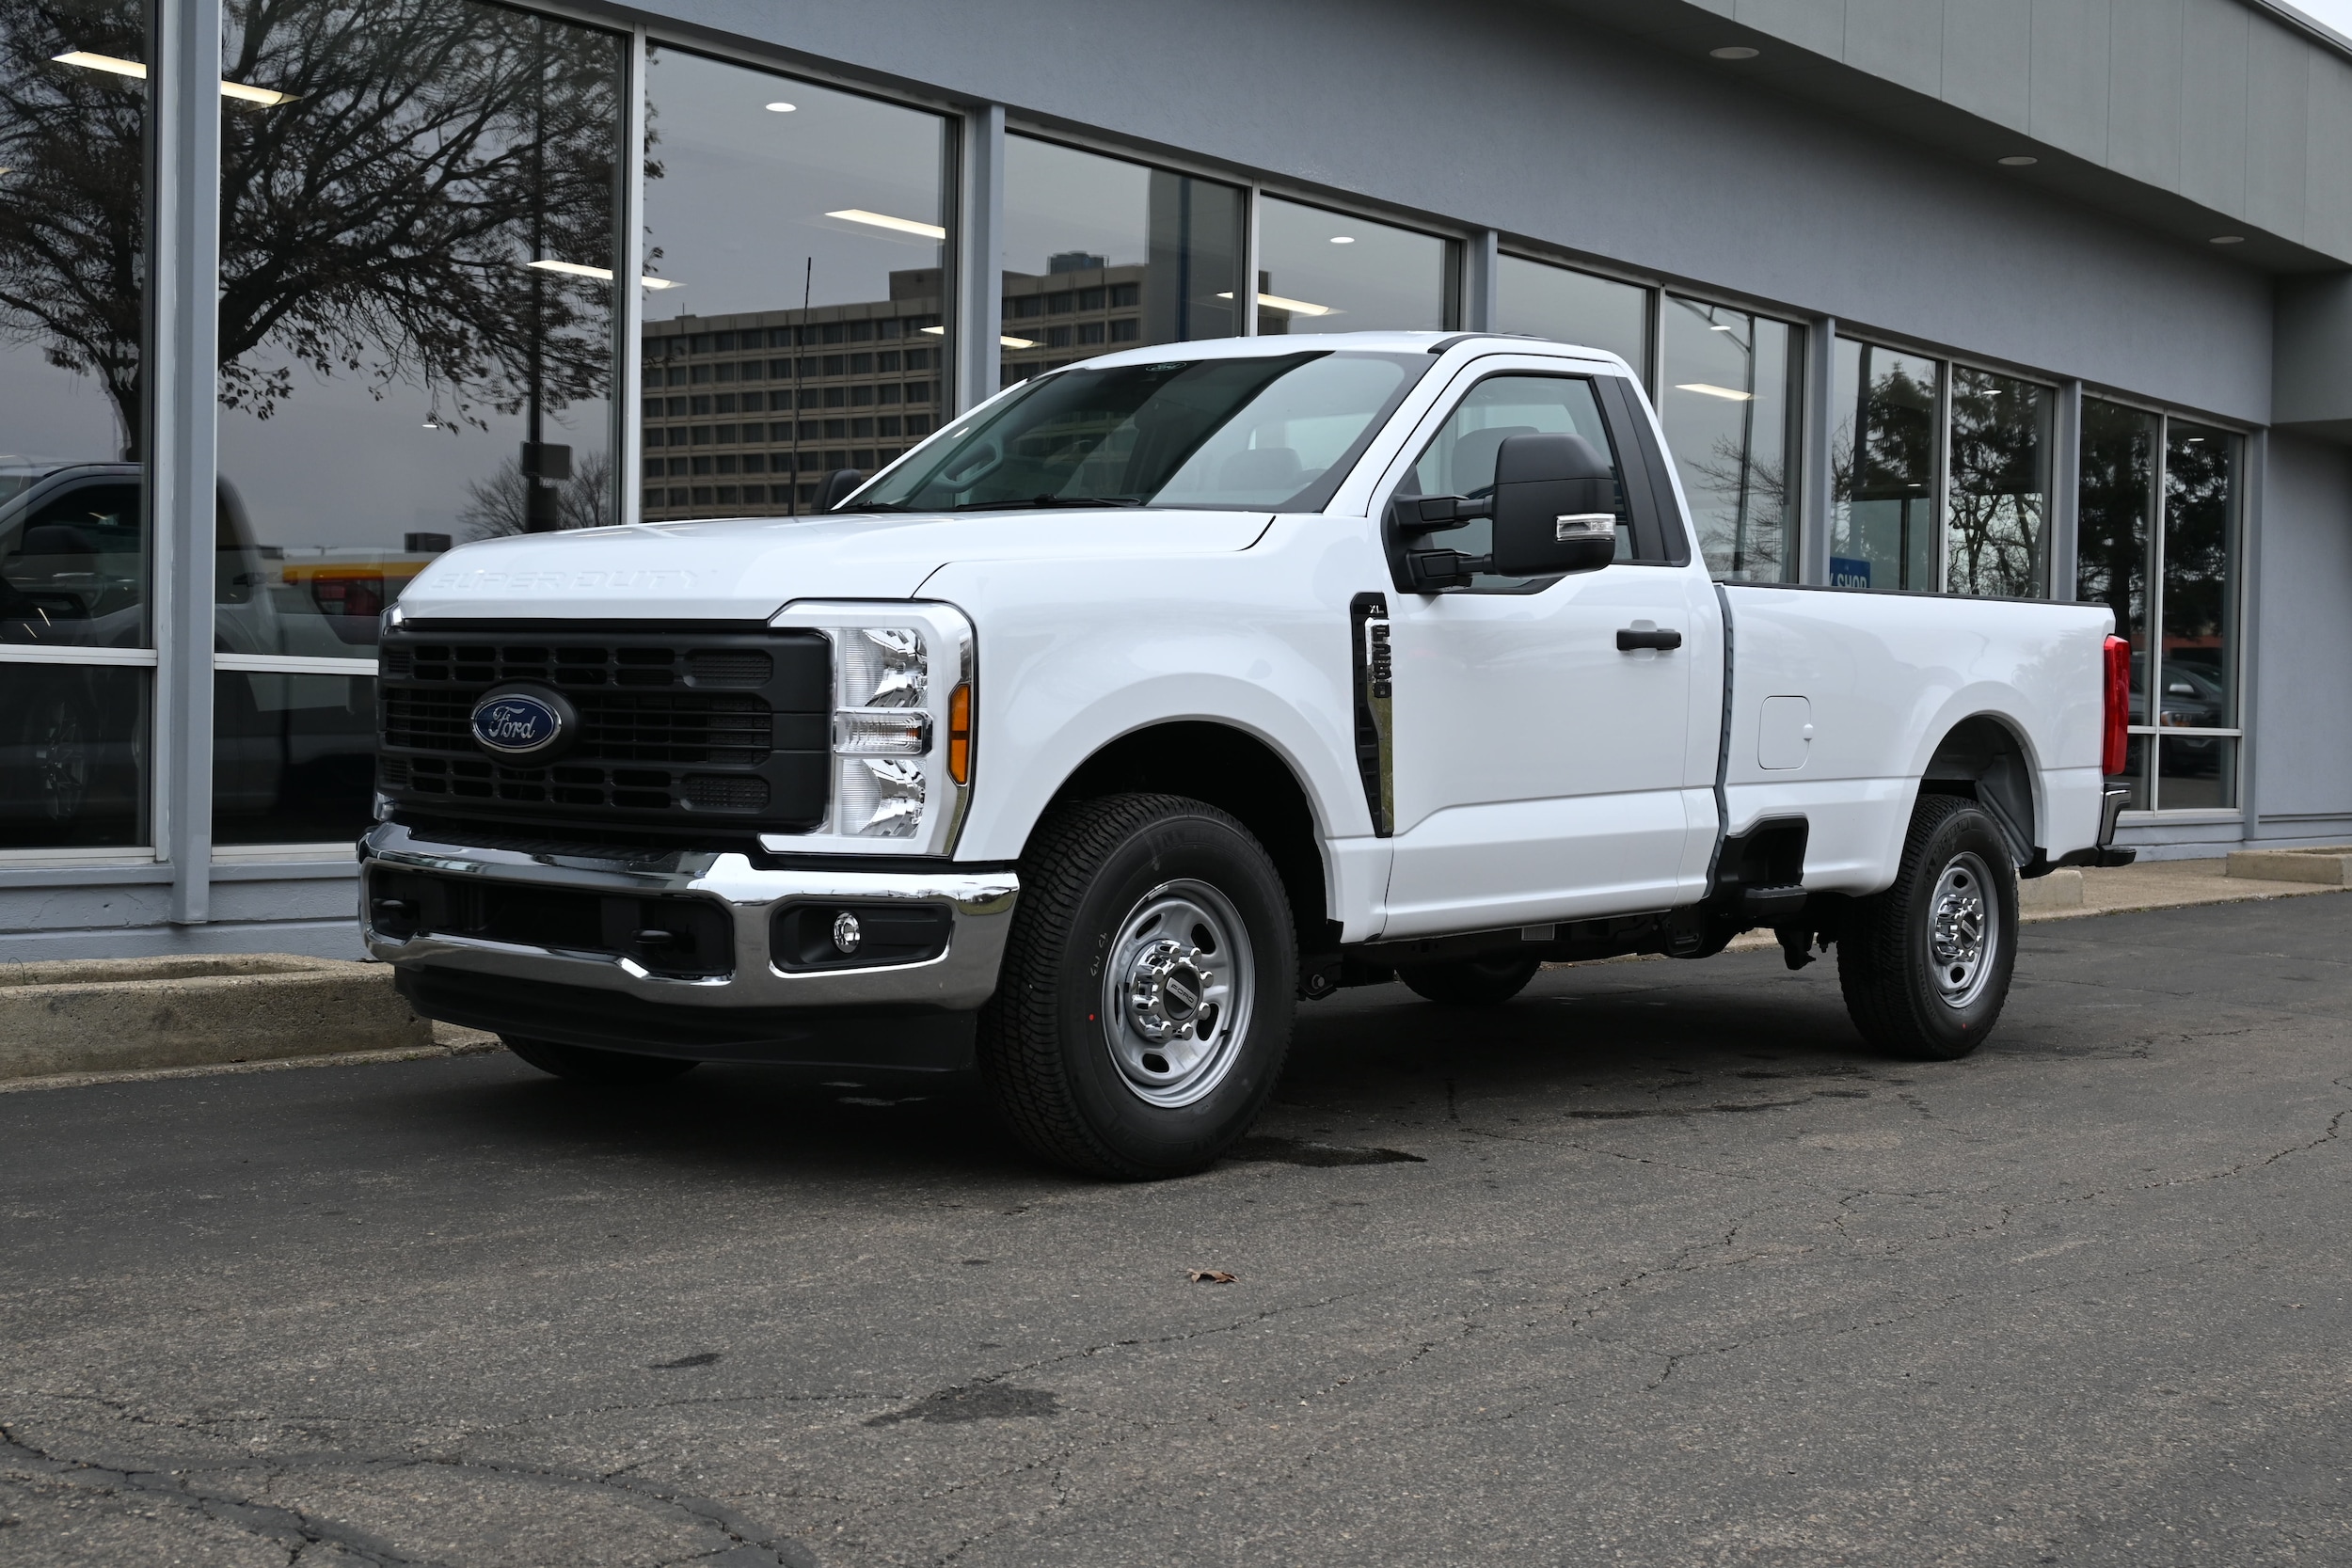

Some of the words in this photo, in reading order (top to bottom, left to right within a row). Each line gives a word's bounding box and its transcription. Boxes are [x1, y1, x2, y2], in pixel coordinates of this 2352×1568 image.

[428, 571, 562, 591] SUPER
[569, 570, 699, 591] DUTY
[1837, 573, 1867, 589] SHOP
[1369, 604, 1385, 614] XL
[488, 705, 536, 739] Ford
[1170, 983, 1195, 1004] FORD
